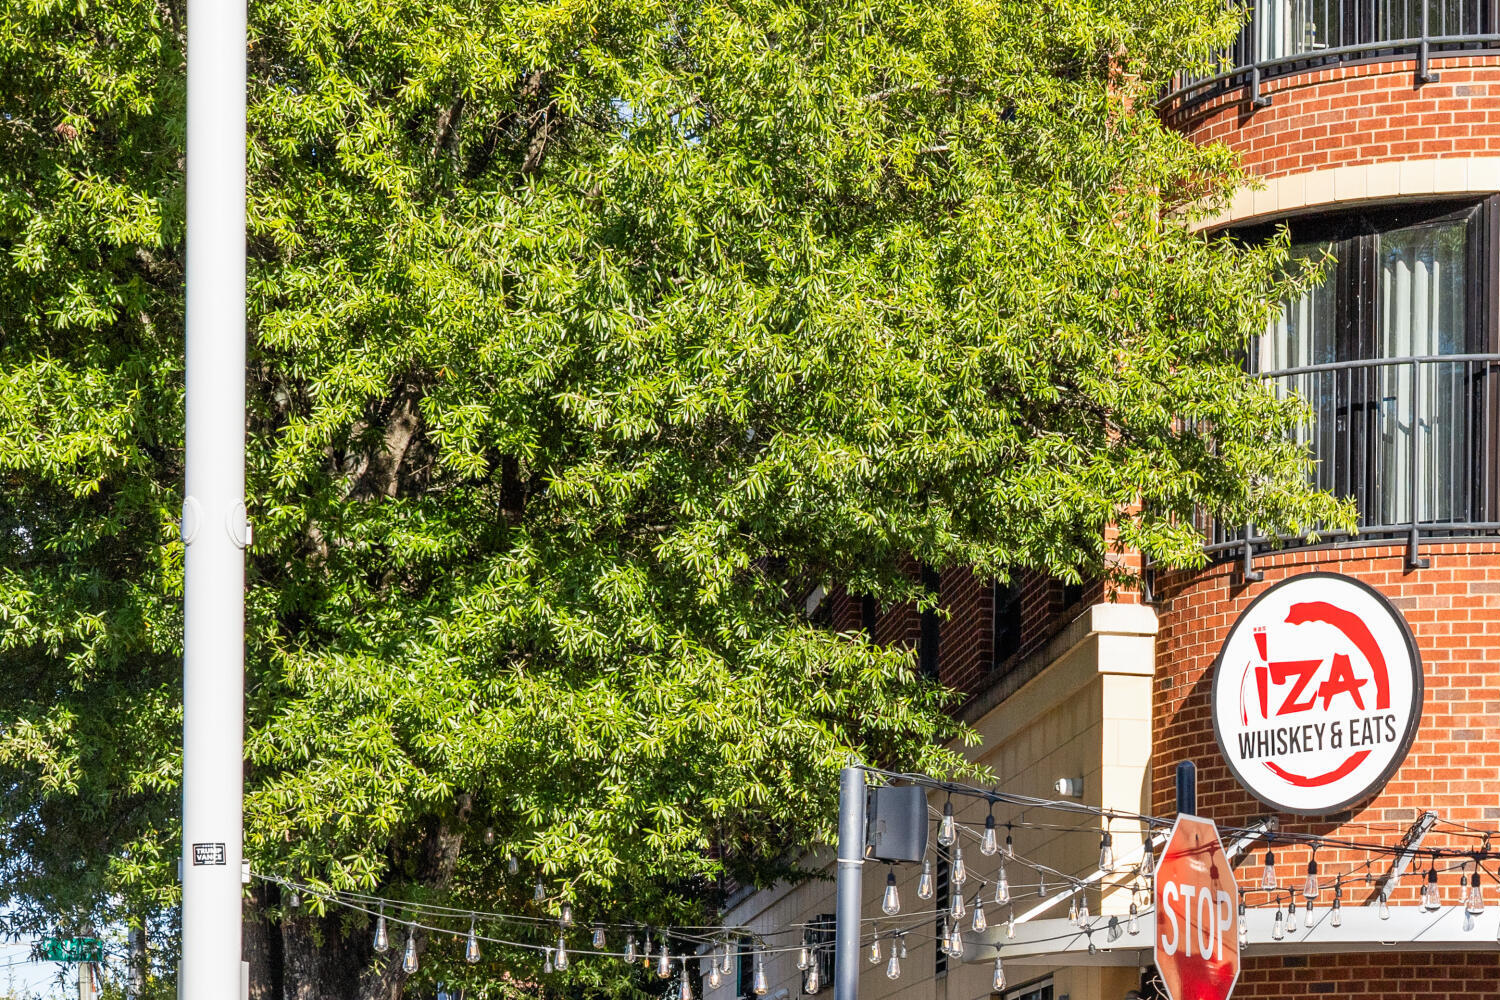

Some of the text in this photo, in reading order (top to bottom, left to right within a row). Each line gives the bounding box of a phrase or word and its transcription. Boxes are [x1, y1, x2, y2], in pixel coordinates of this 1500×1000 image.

[1238, 714, 1397, 760] WHISKEY & EATS
[1161, 880, 1233, 961] STOP
